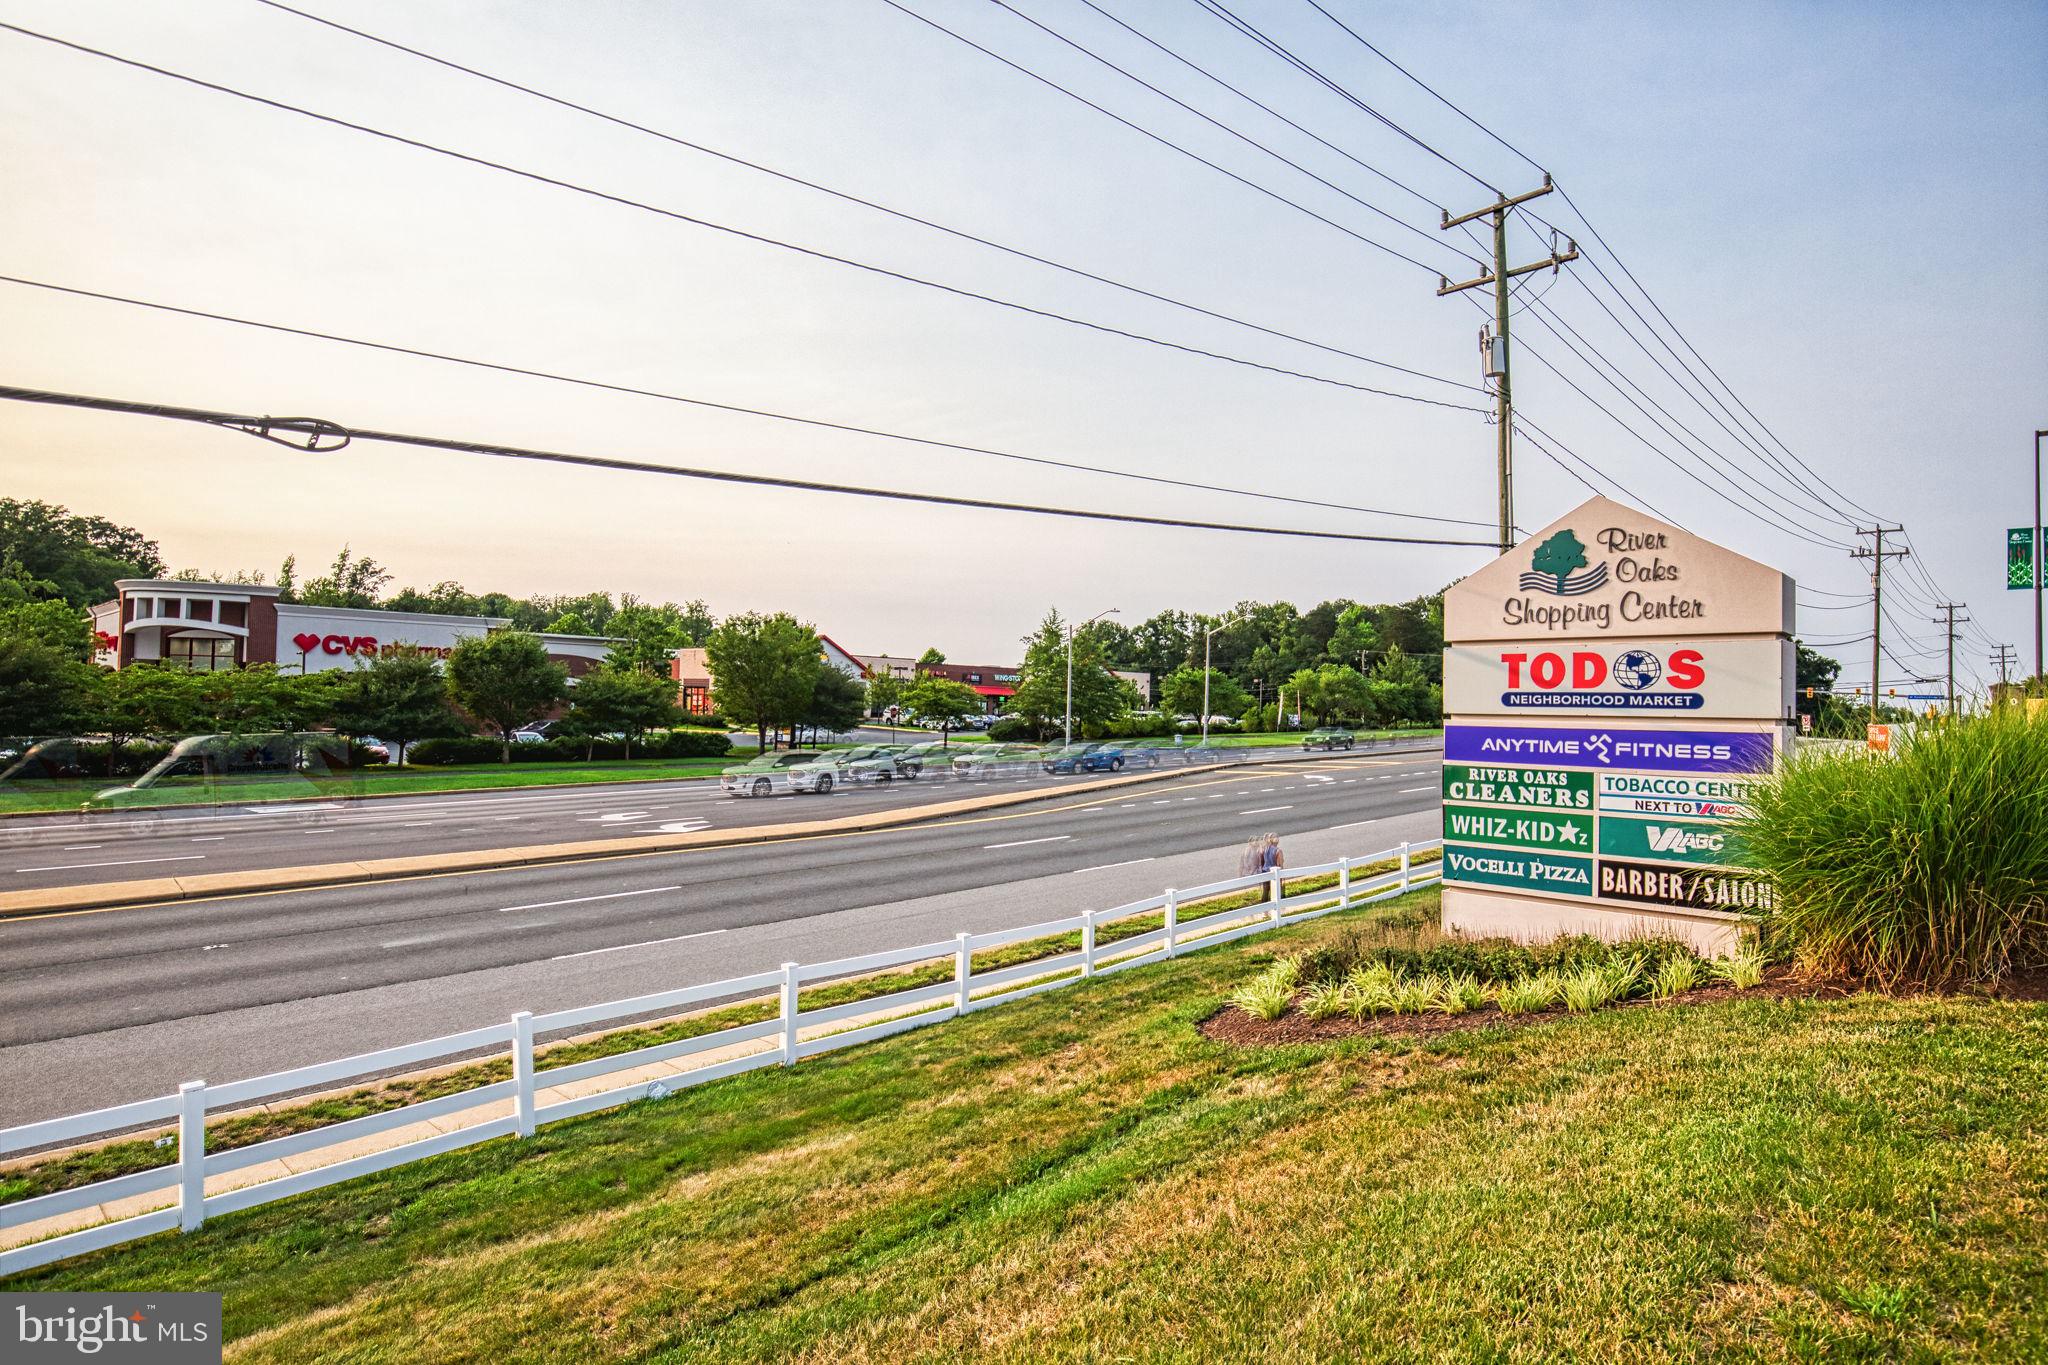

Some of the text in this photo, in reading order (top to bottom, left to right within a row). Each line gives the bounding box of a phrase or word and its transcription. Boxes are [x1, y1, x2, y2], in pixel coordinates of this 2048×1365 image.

[1596, 527, 1667, 552] River
[1616, 557, 1678, 583] Oaks
[1502, 590, 1705, 630] Shopping Center
[322, 634, 378, 656] CVS
[1510, 694, 1694, 707] NEIGHBORHOOD MARKET
[1481, 738, 1731, 760] ANYTIME FITNESS
[1469, 768, 1568, 785] RIVER OAKS
[1605, 777, 1690, 795] TOBACCO
[1449, 782, 1589, 808] CLEANERS
[1634, 800, 1670, 812] NEXT
[1674, 802, 1692, 813] TO
[1448, 853, 1590, 884] VOCELLI PIZZA
